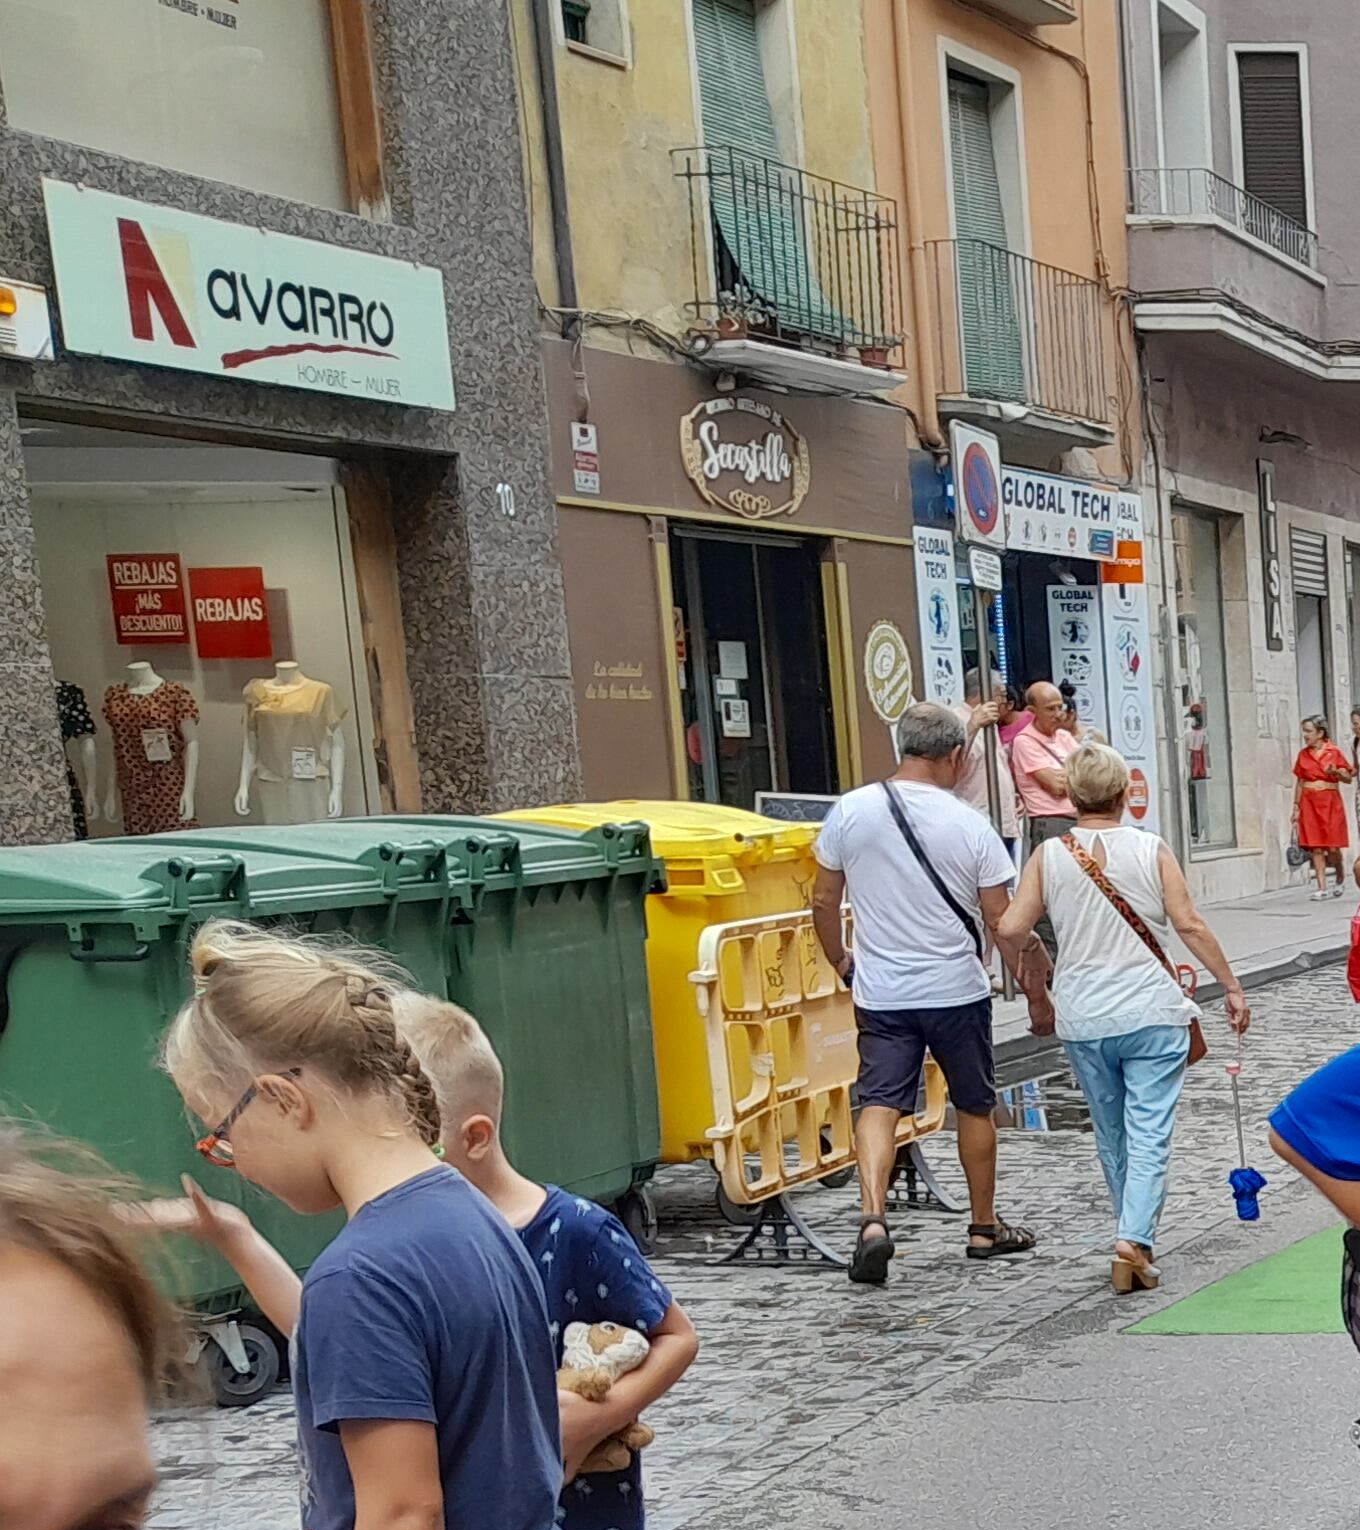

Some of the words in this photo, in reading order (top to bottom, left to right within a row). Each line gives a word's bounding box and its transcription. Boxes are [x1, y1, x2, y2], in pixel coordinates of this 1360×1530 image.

[297, 364, 348, 389] HOMBRE
[365, 378, 401, 396] MUJER
[700, 421, 792, 484] Secastilla
[1002, 476, 1066, 515] GLOBAL
[1071, 489, 1112, 523] TECH
[918, 535, 951, 557] GLOBAL
[1264, 472, 1284, 640] LISA
[112, 561, 177, 585] REBAJAS
[924, 560, 948, 580] TECH
[1052, 589, 1094, 600] GLOBAL
[195, 597, 264, 622] REBAJAS
[1060, 603, 1088, 613] TECH
[120, 614, 184, 631] DESCUENTO!
